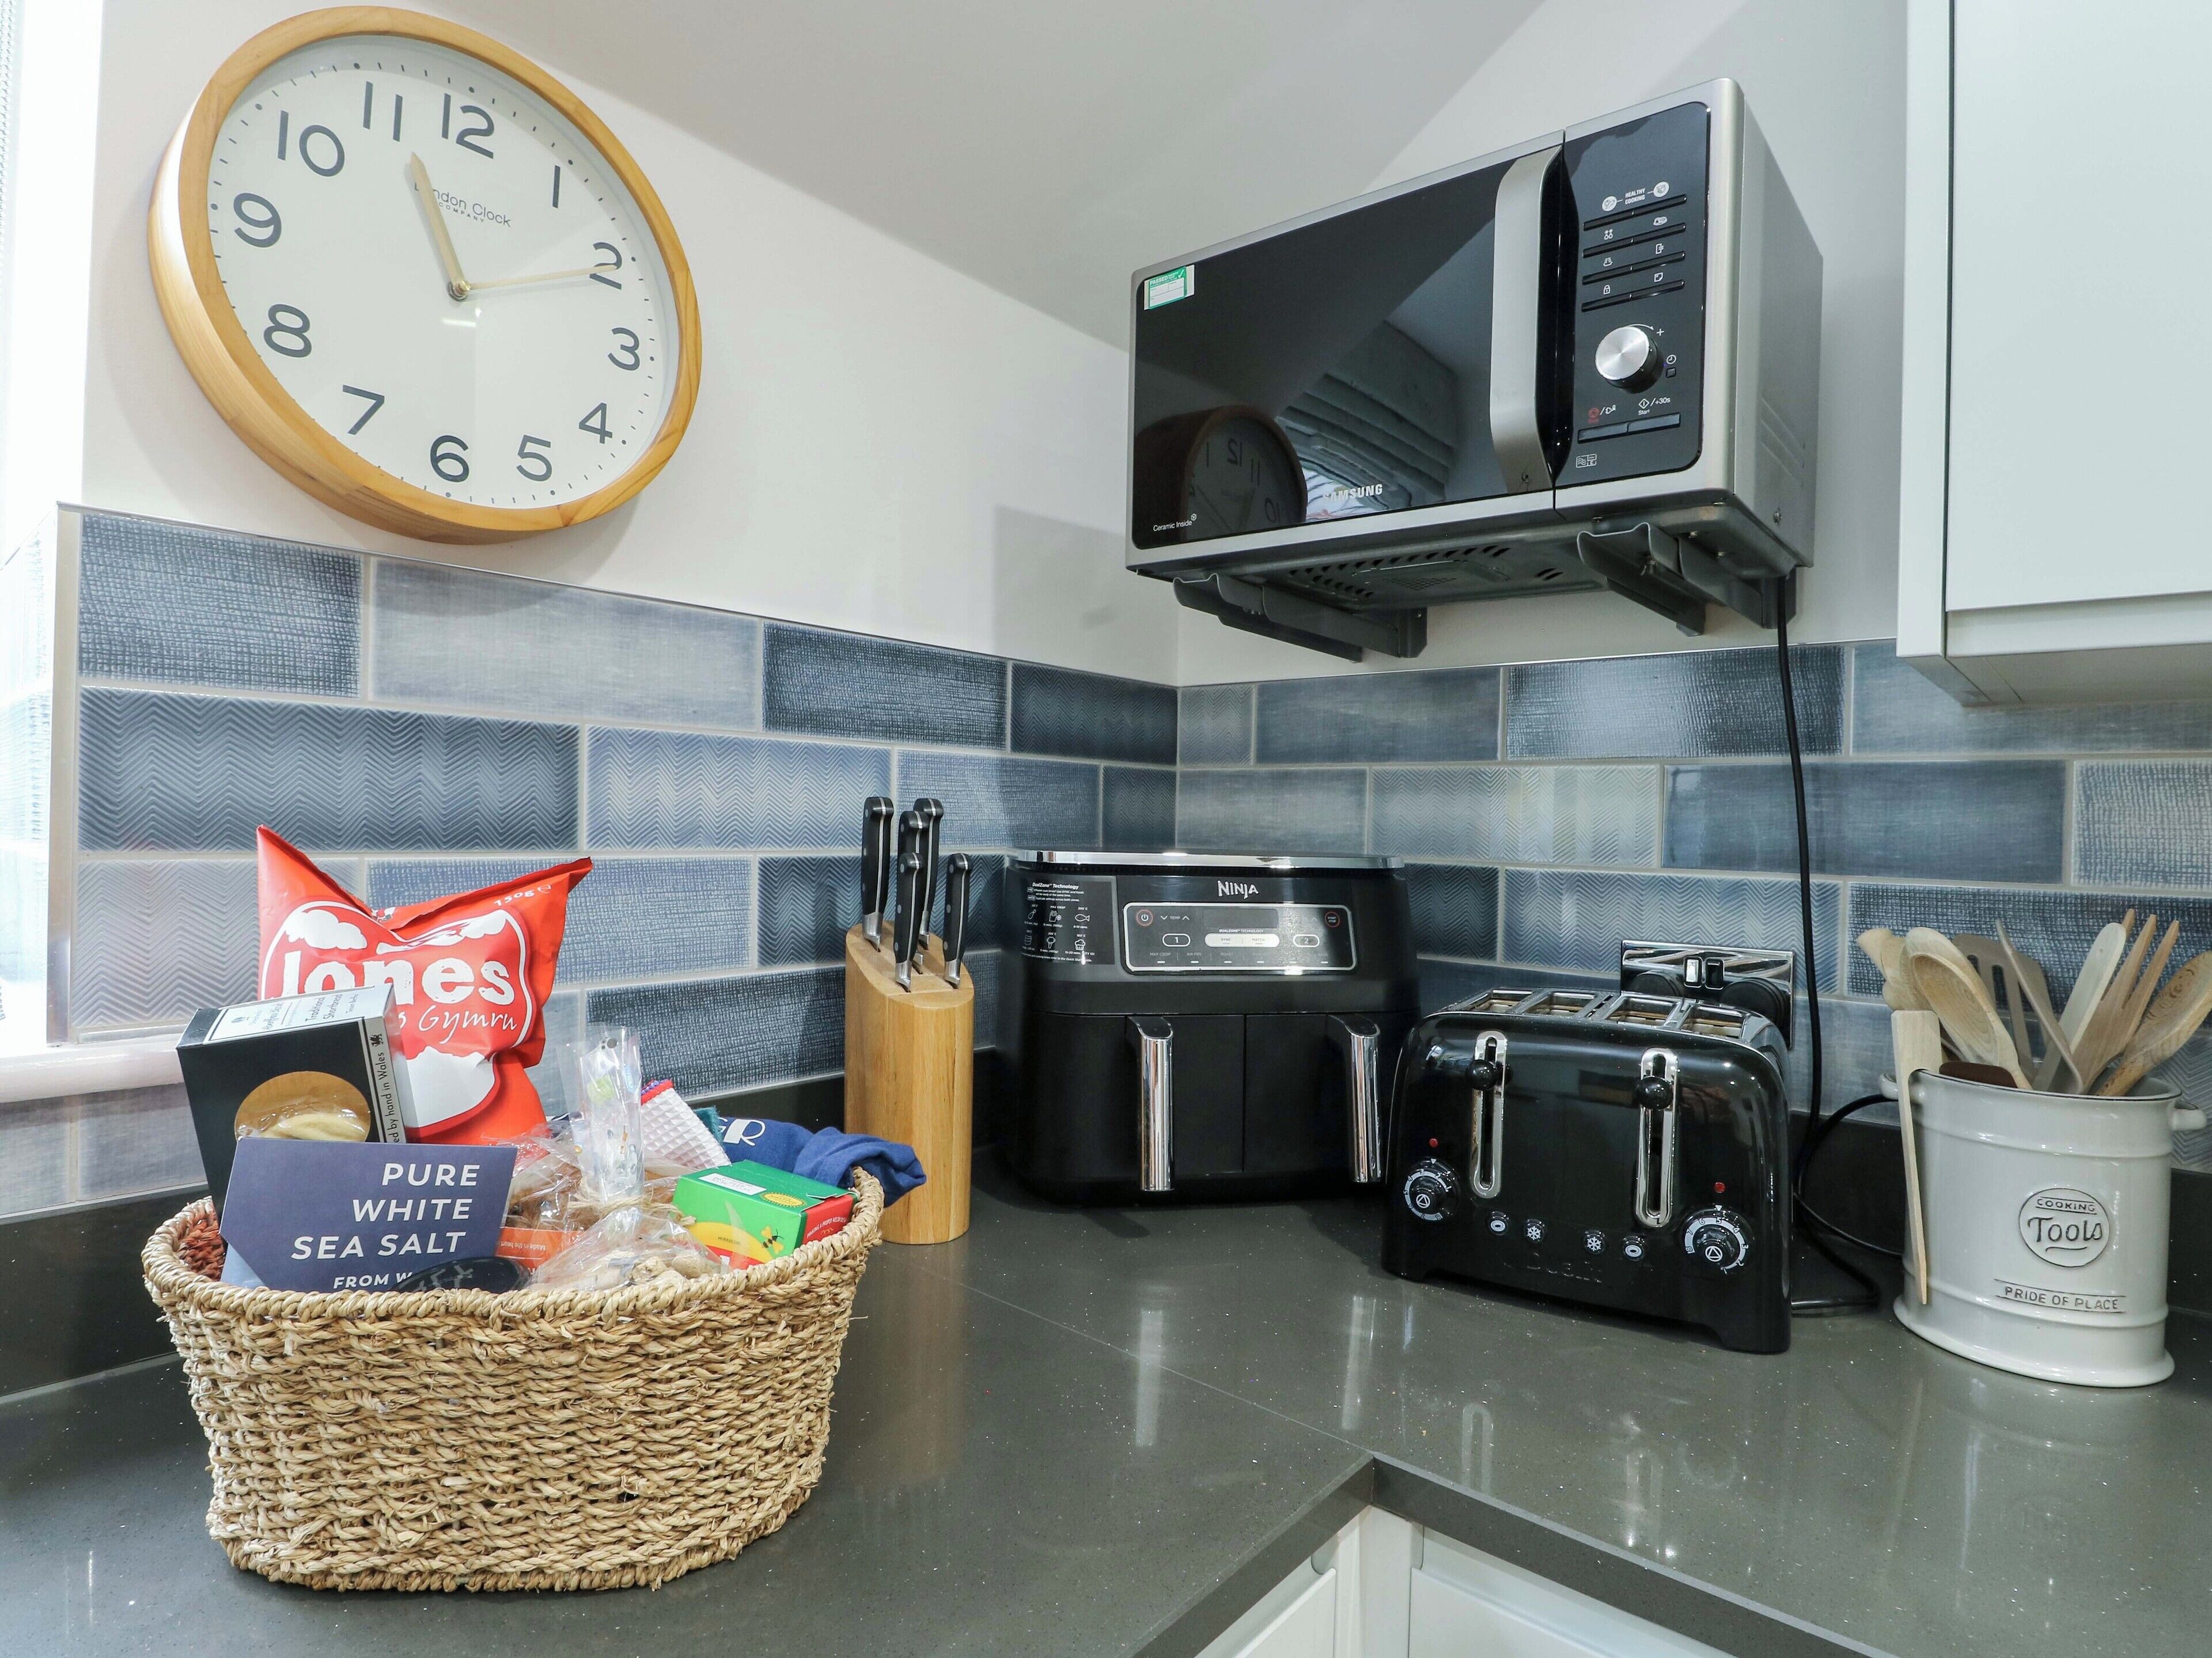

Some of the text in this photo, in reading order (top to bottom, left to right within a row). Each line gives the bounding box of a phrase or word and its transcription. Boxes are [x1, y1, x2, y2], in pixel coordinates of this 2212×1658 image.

[363, 81, 403, 142] 11
[441, 93, 494, 158] 12
[278, 110, 344, 177] 10
[552, 165, 560, 208] 1
[1625, 188, 1646, 198] HEALTHY
[1625, 195, 1645, 204] COOKING
[415, 183, 511, 228] Lndon Clock
[439, 202, 485, 223] COMPANY
[233, 192, 282, 248] 9
[589, 241, 622, 290] 2
[1150, 276, 1168, 285] PASSED
[263, 303, 312, 358] 8
[608, 327, 640, 371] 3
[342, 385, 385, 435] 7
[578, 403, 613, 444] 4
[430, 435, 469, 483] 6
[516, 434, 552, 481] 5
[1323, 483, 1383, 503] SAMSUNG
[1153, 519, 1192, 532] Ceramic Inside
[305, 996, 325, 1022] Traditional
[323, 993, 343, 1019] Shortbread
[418, 1005, 517, 1045] Gymru
[375, 1052, 387, 1080] Wales
[382, 1082, 391, 1091] in
[381, 1094, 395, 1117] hand
[387, 1118, 399, 1132] by
[381, 1162, 480, 1187] PURE
[352, 1198, 473, 1223] WHITE
[2037, 1198, 2096, 1212] COOKING
[2027, 1217, 2103, 1243] Tools
[290, 1231, 467, 1261] SEA SALT
[529, 1243, 546, 1251] Made
[332, 1273, 390, 1289] FROM
[2005, 1286, 2119, 1310] PRIDE OF PLACE
